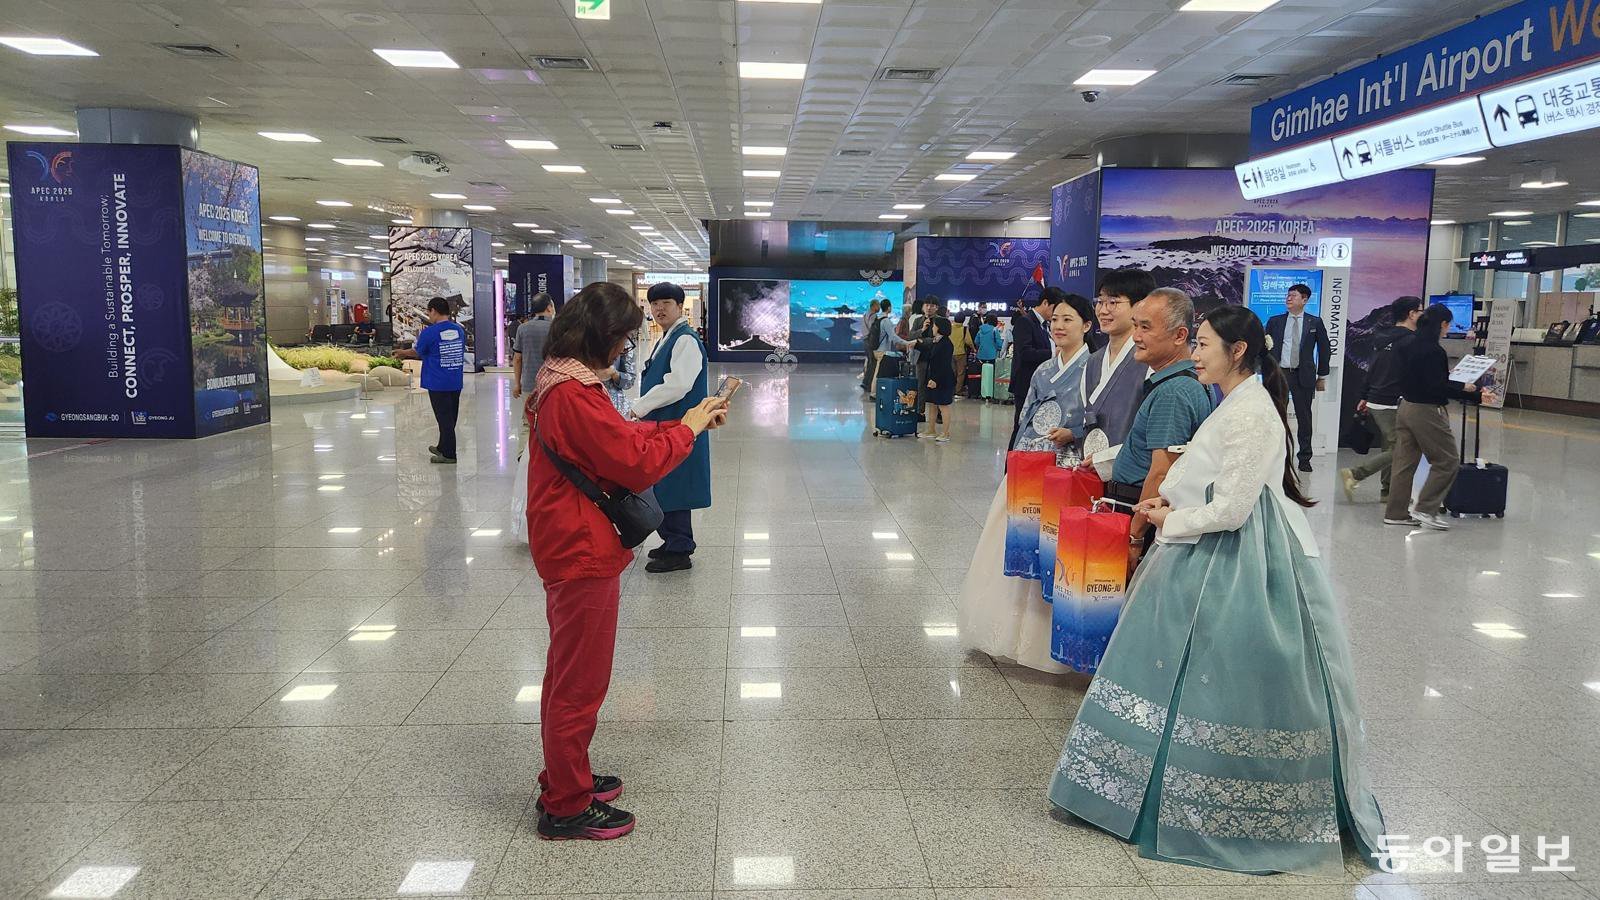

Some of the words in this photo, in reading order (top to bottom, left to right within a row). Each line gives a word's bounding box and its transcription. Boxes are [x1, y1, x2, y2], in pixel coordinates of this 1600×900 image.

[1270, 94, 1349, 143] Gimhae
[1356, 62, 1408, 115] Int'l
[1416, 18, 1534, 97] Airport
[1374, 134, 1415, 157] 셔틀버스
[1264, 166, 1286, 182] 화장실
[31, 187, 50, 195] APEC
[53, 187, 73, 195] 2025
[113, 173, 130, 249] INNOVATE
[199, 202, 215, 219] APEC
[214, 205, 230, 222] 2025
[230, 208, 249, 225] KOREA
[198, 229, 222, 243] WELCOME
[1214, 220, 1245, 234] APEC
[1246, 220, 1276, 235] 2025
[1278, 220, 1315, 235] KOREA
[404, 252, 420, 261] APEC
[437, 253, 458, 262] KOREA
[1210, 244, 1254, 257] WELCOME
[1256, 244, 1268, 257] TO
[1269, 244, 1304, 257] GYEONG
[102, 257, 116, 321] Sustainable
[119, 253, 134, 323] PROSPER,
[1328, 278, 1342, 356] INFORMATION
[107, 333, 119, 378] Building
[122, 326, 138, 399] CONNECT,
[60, 413, 120, 422] GYEONGSANGBUK-DO
[1086, 583, 1121, 593] GYEONG-JU
